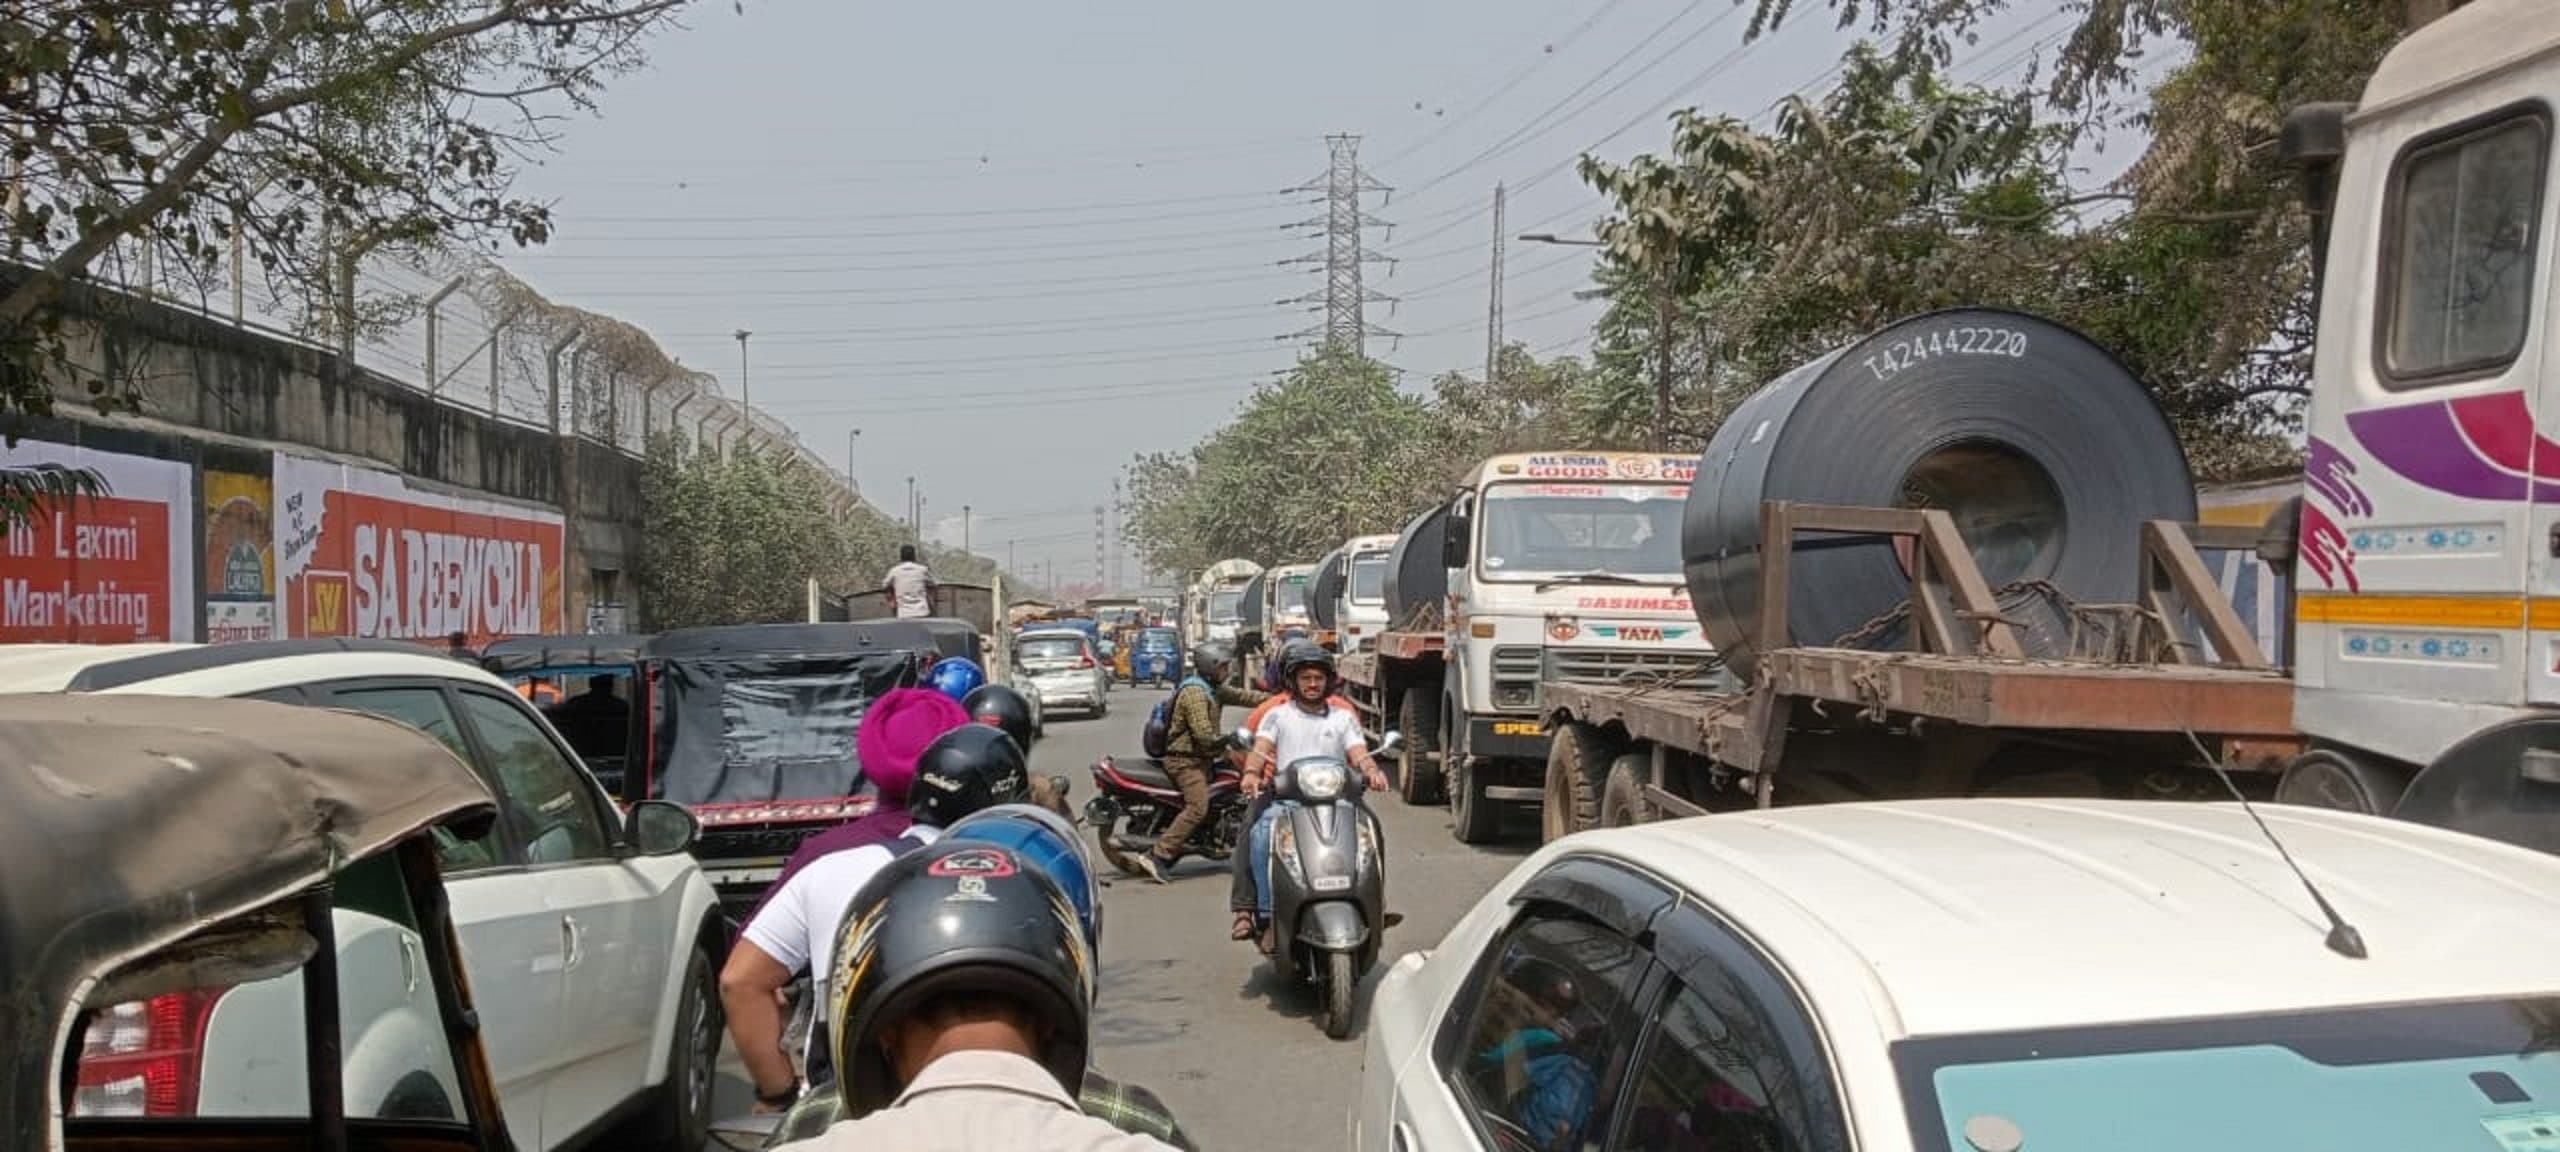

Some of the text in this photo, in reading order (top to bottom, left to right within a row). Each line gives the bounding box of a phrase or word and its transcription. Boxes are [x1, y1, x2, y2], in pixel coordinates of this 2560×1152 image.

[1863, 327, 2028, 381] T424442220
[1529, 456, 1556, 466] ALL
[1562, 456, 1608, 466] INDIA
[1527, 467, 1610, 478] GOODS
[355, 523, 543, 639] SAREEWORLD
[3, 578, 149, 635] Marketing
[1577, 598, 1690, 610] DASHMES
[1618, 627, 1663, 641] TATA
